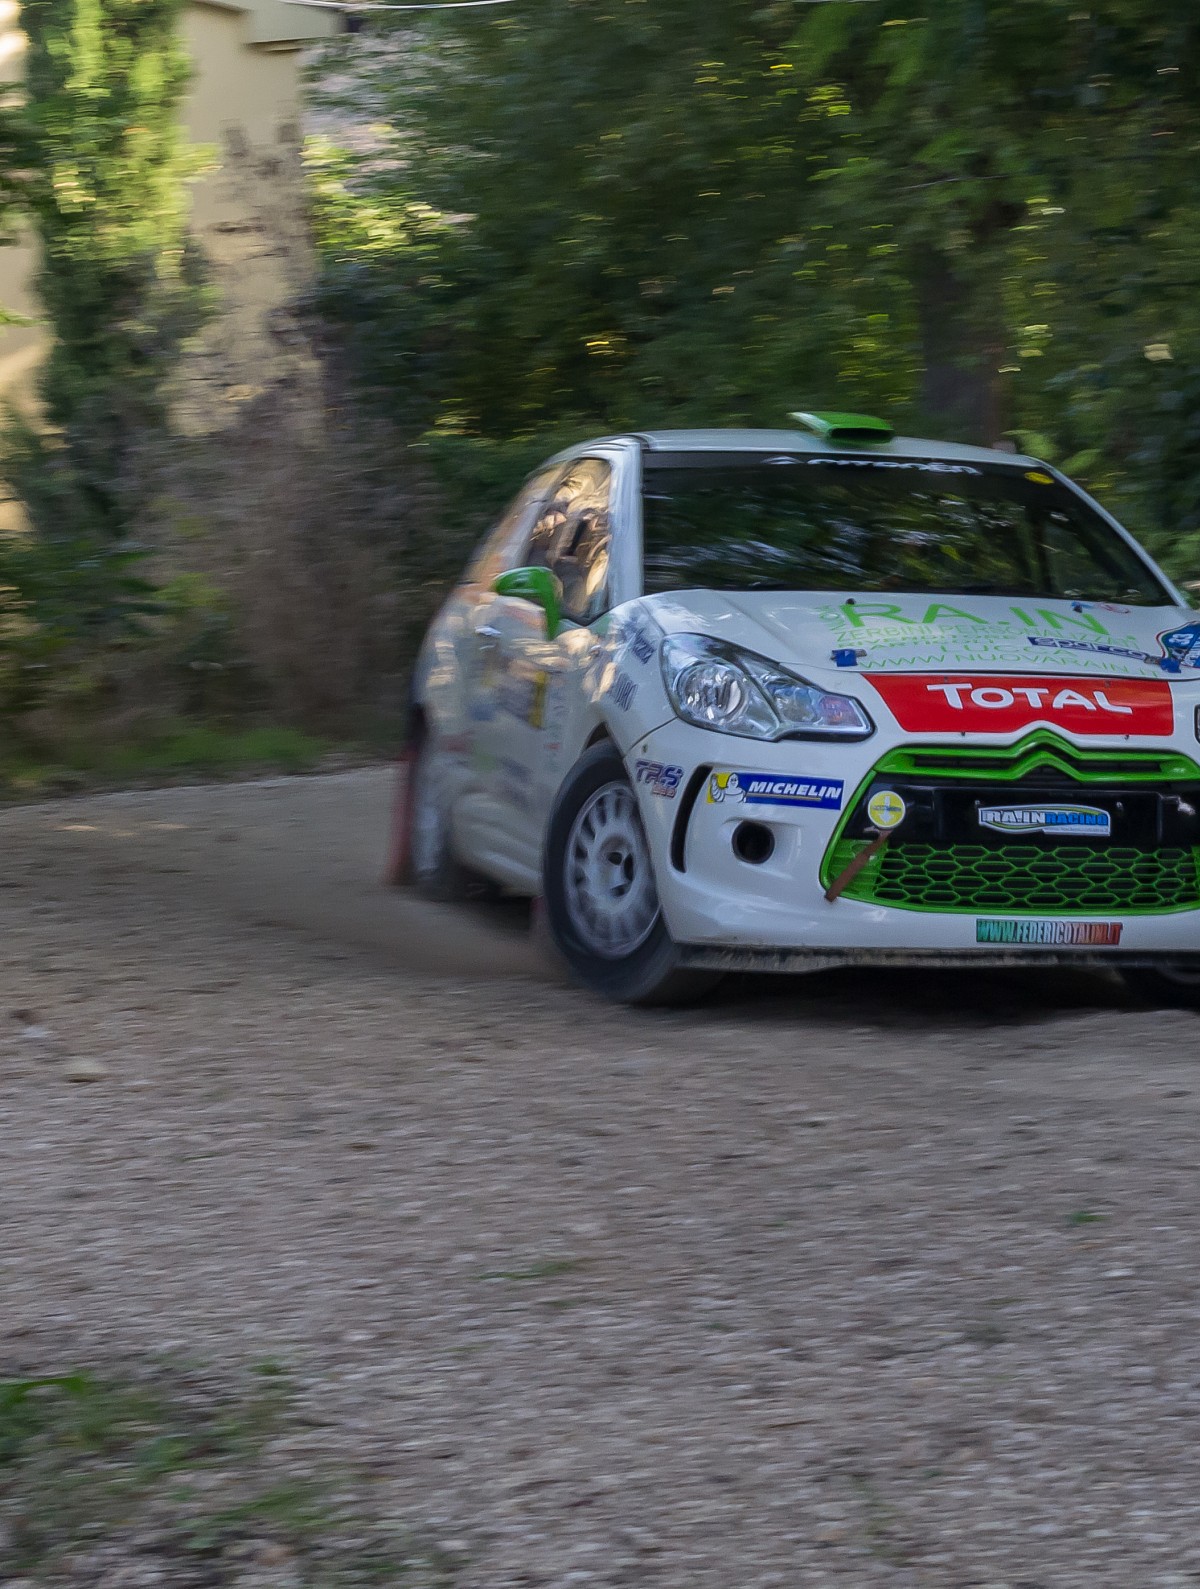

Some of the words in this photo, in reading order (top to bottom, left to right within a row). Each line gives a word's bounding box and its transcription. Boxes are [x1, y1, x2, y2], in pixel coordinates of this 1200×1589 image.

[839, 603, 1109, 635] RA.IN
[833, 625, 932, 643] ZERBINI
[927, 683, 1132, 714] TOTAL
[748, 781, 841, 799] MICHELIN
